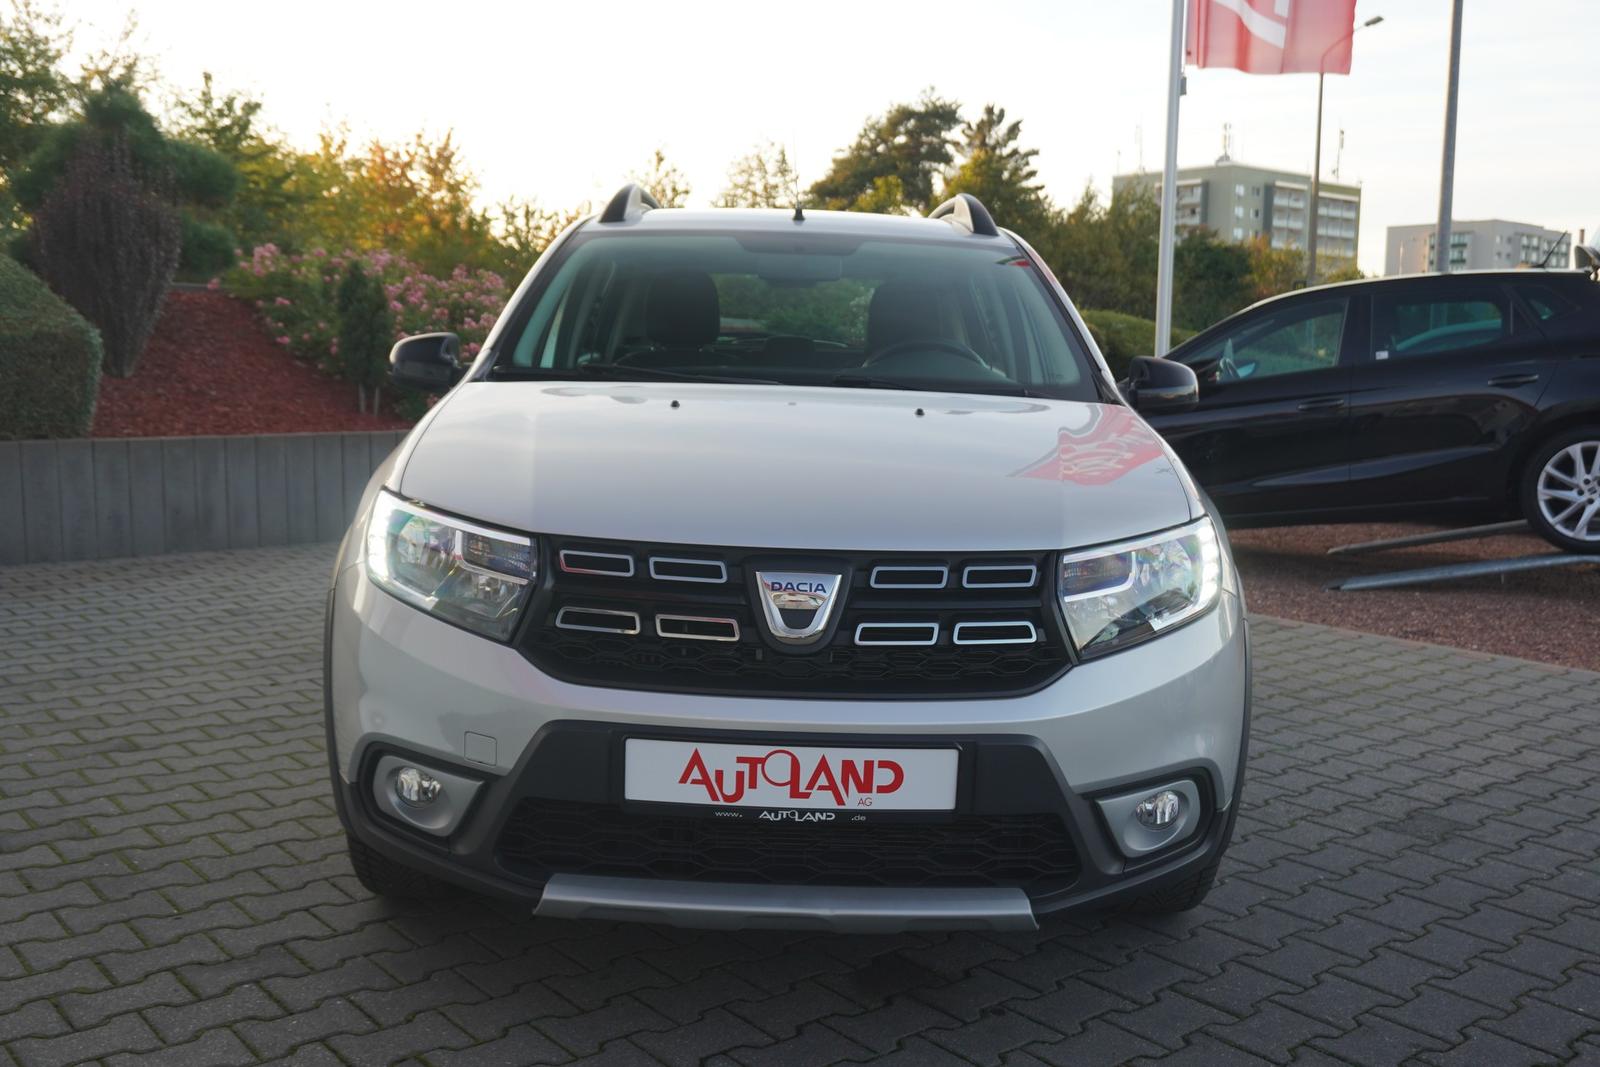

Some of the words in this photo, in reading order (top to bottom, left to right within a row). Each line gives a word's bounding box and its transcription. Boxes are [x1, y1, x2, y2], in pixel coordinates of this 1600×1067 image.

[771, 582, 826, 593] DACIA
[678, 748, 904, 806] AUTOLAND
[857, 797, 873, 807] AG
[759, 810, 836, 822] AUTOLAND
